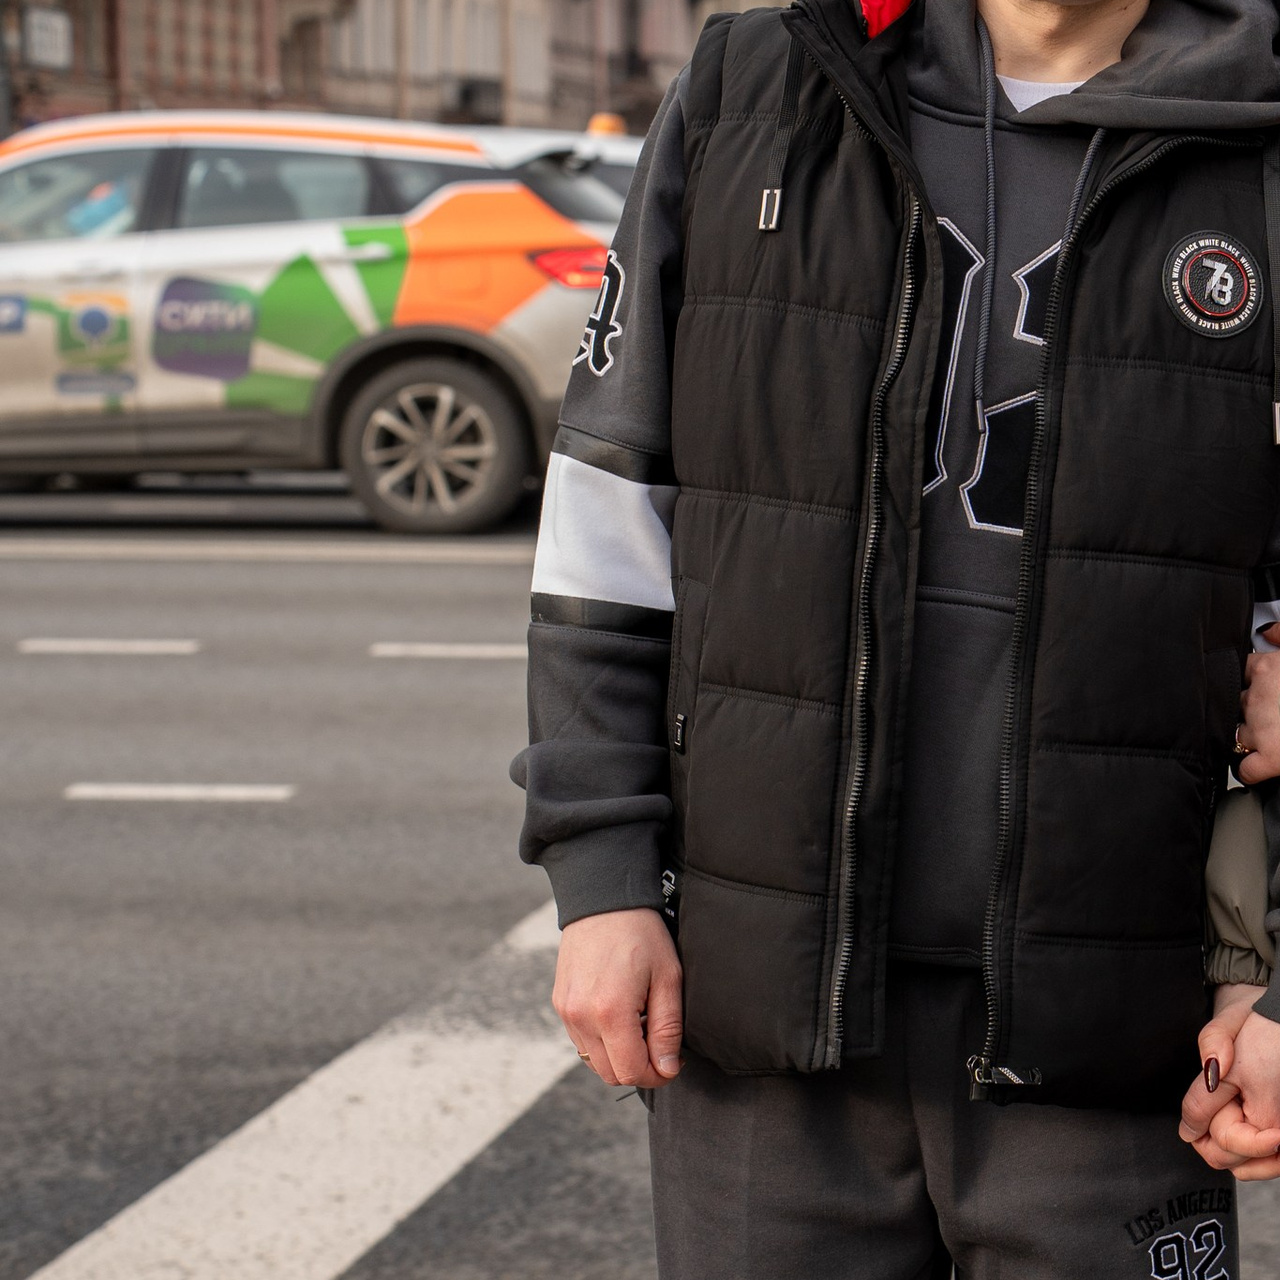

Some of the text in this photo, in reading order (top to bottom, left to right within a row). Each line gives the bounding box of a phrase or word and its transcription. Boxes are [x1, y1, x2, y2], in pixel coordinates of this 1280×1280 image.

[1180, 242, 1198, 258] BLACK
[1198, 239, 1219, 247] WHITE
[1220, 239, 1240, 257] BLACK
[1172, 257, 1183, 278] WHITE
[1240, 256, 1254, 277] WHITE
[1202, 258, 1234, 306] 78
[1172, 280, 1184, 304] BLACK
[1179, 306, 1198, 323] WHITE
[1239, 302, 1254, 321] BLACK
[1220, 319, 1241, 330] WHITE
[1124, 1188, 1233, 1246] LOS ANGELES
